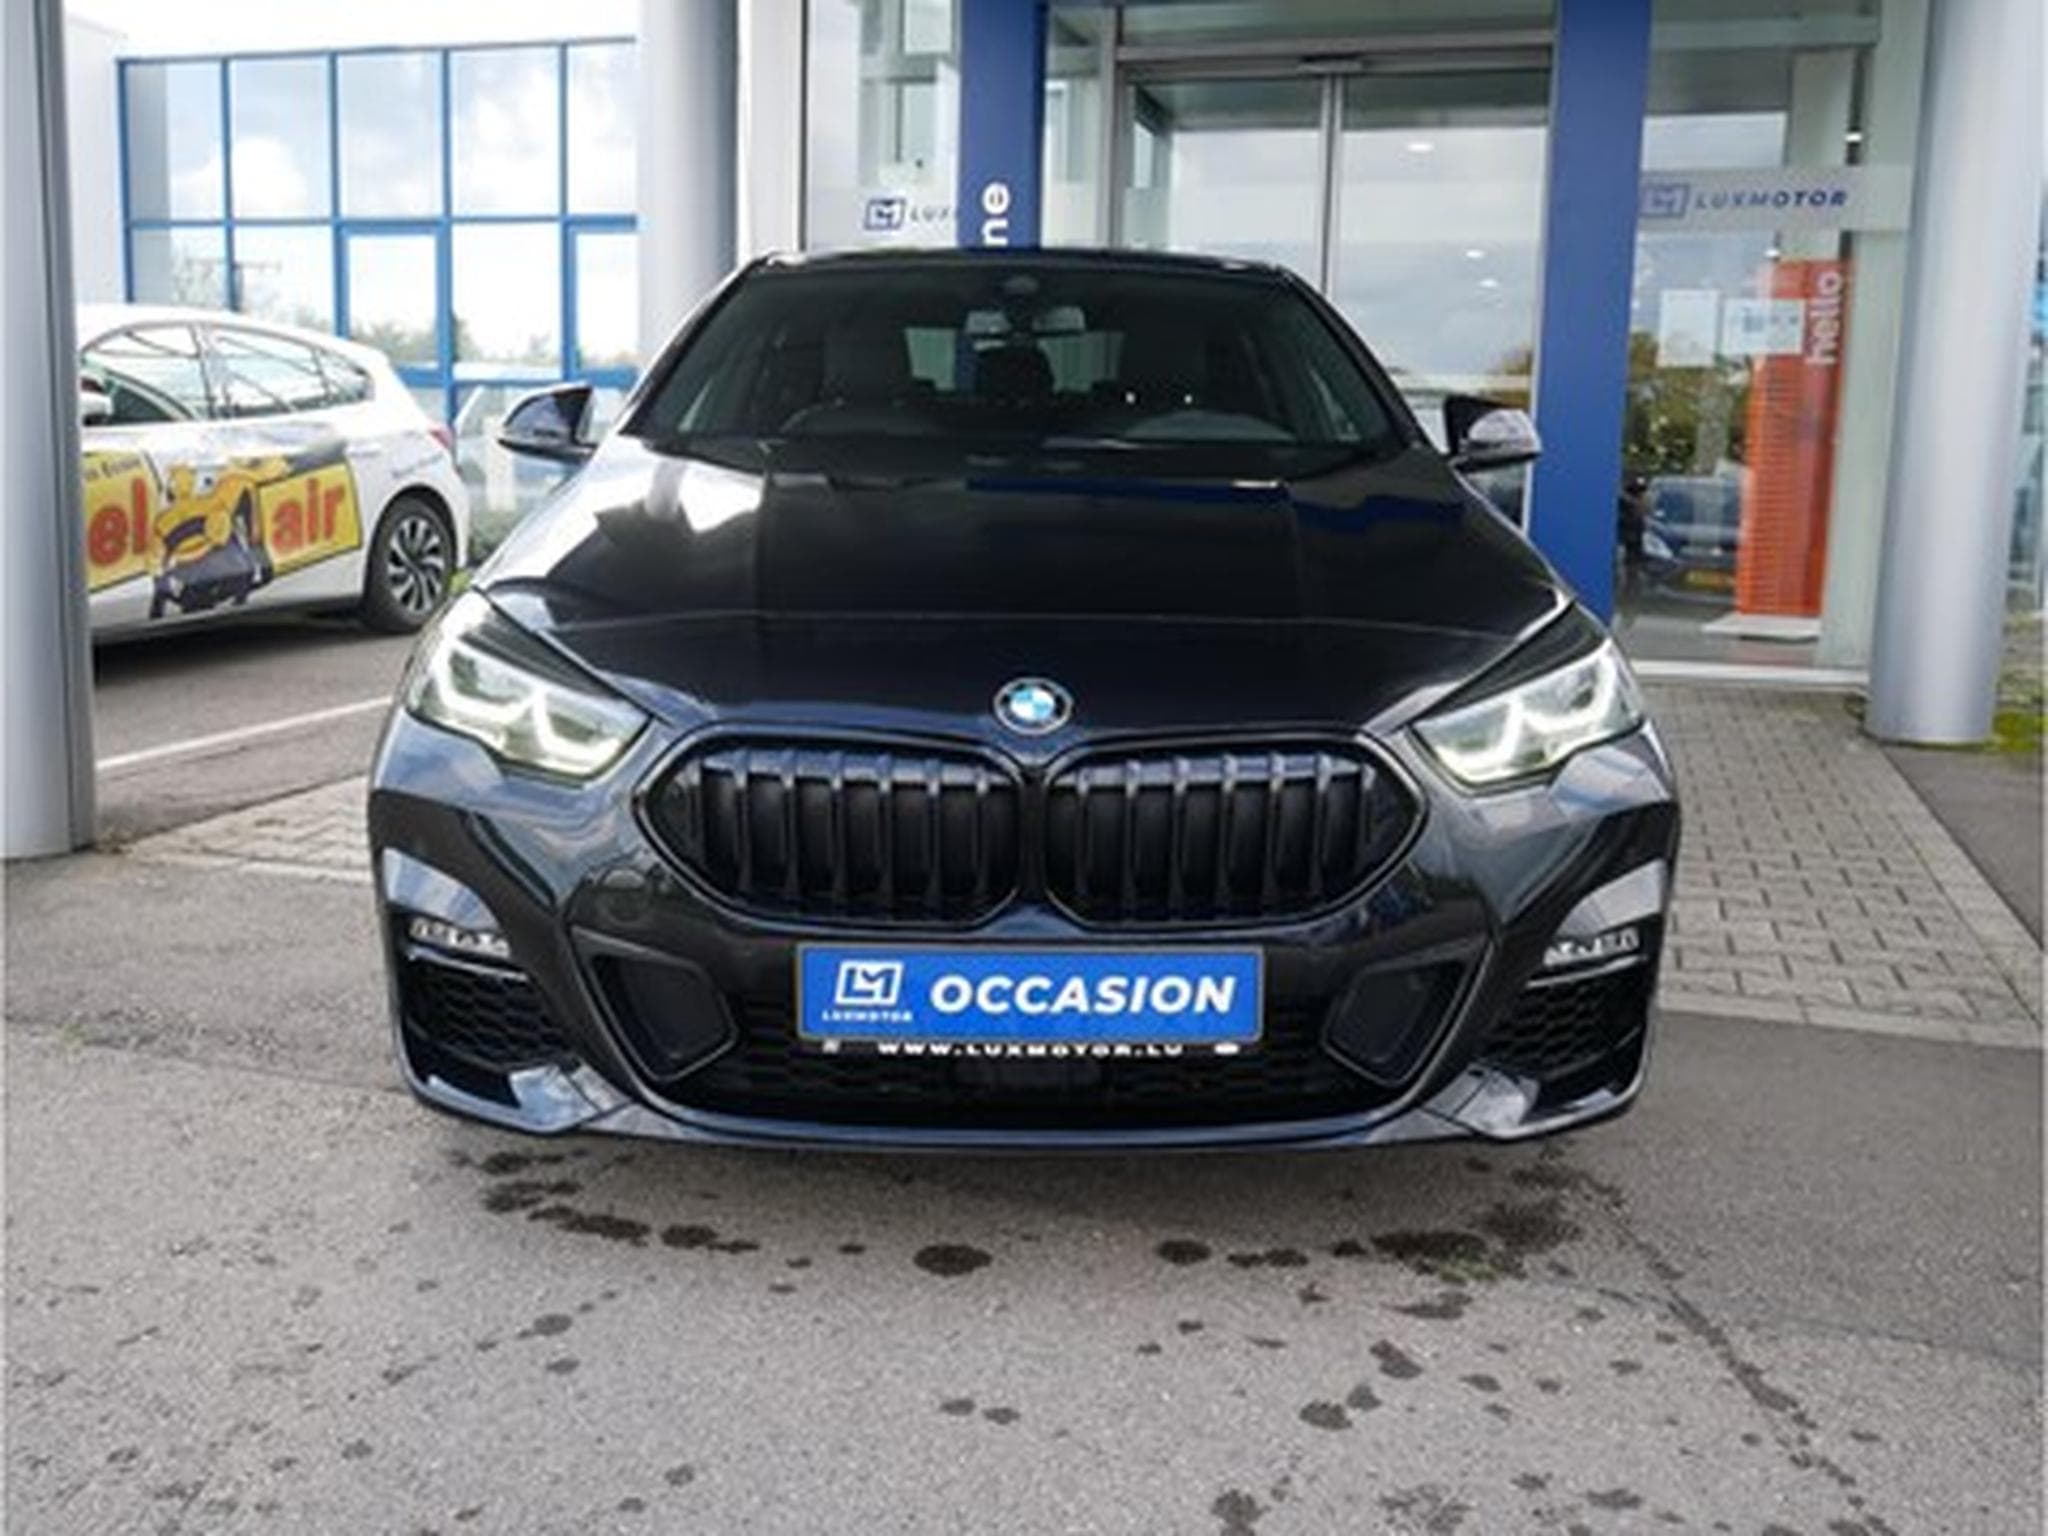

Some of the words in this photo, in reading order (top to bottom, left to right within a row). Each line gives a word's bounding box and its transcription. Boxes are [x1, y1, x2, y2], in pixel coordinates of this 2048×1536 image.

[1696, 190, 1847, 209] LUXMOTOR
[1804, 270, 1842, 364] hello
[273, 477, 347, 554] air
[930, 975, 1236, 1014] OCCASION
